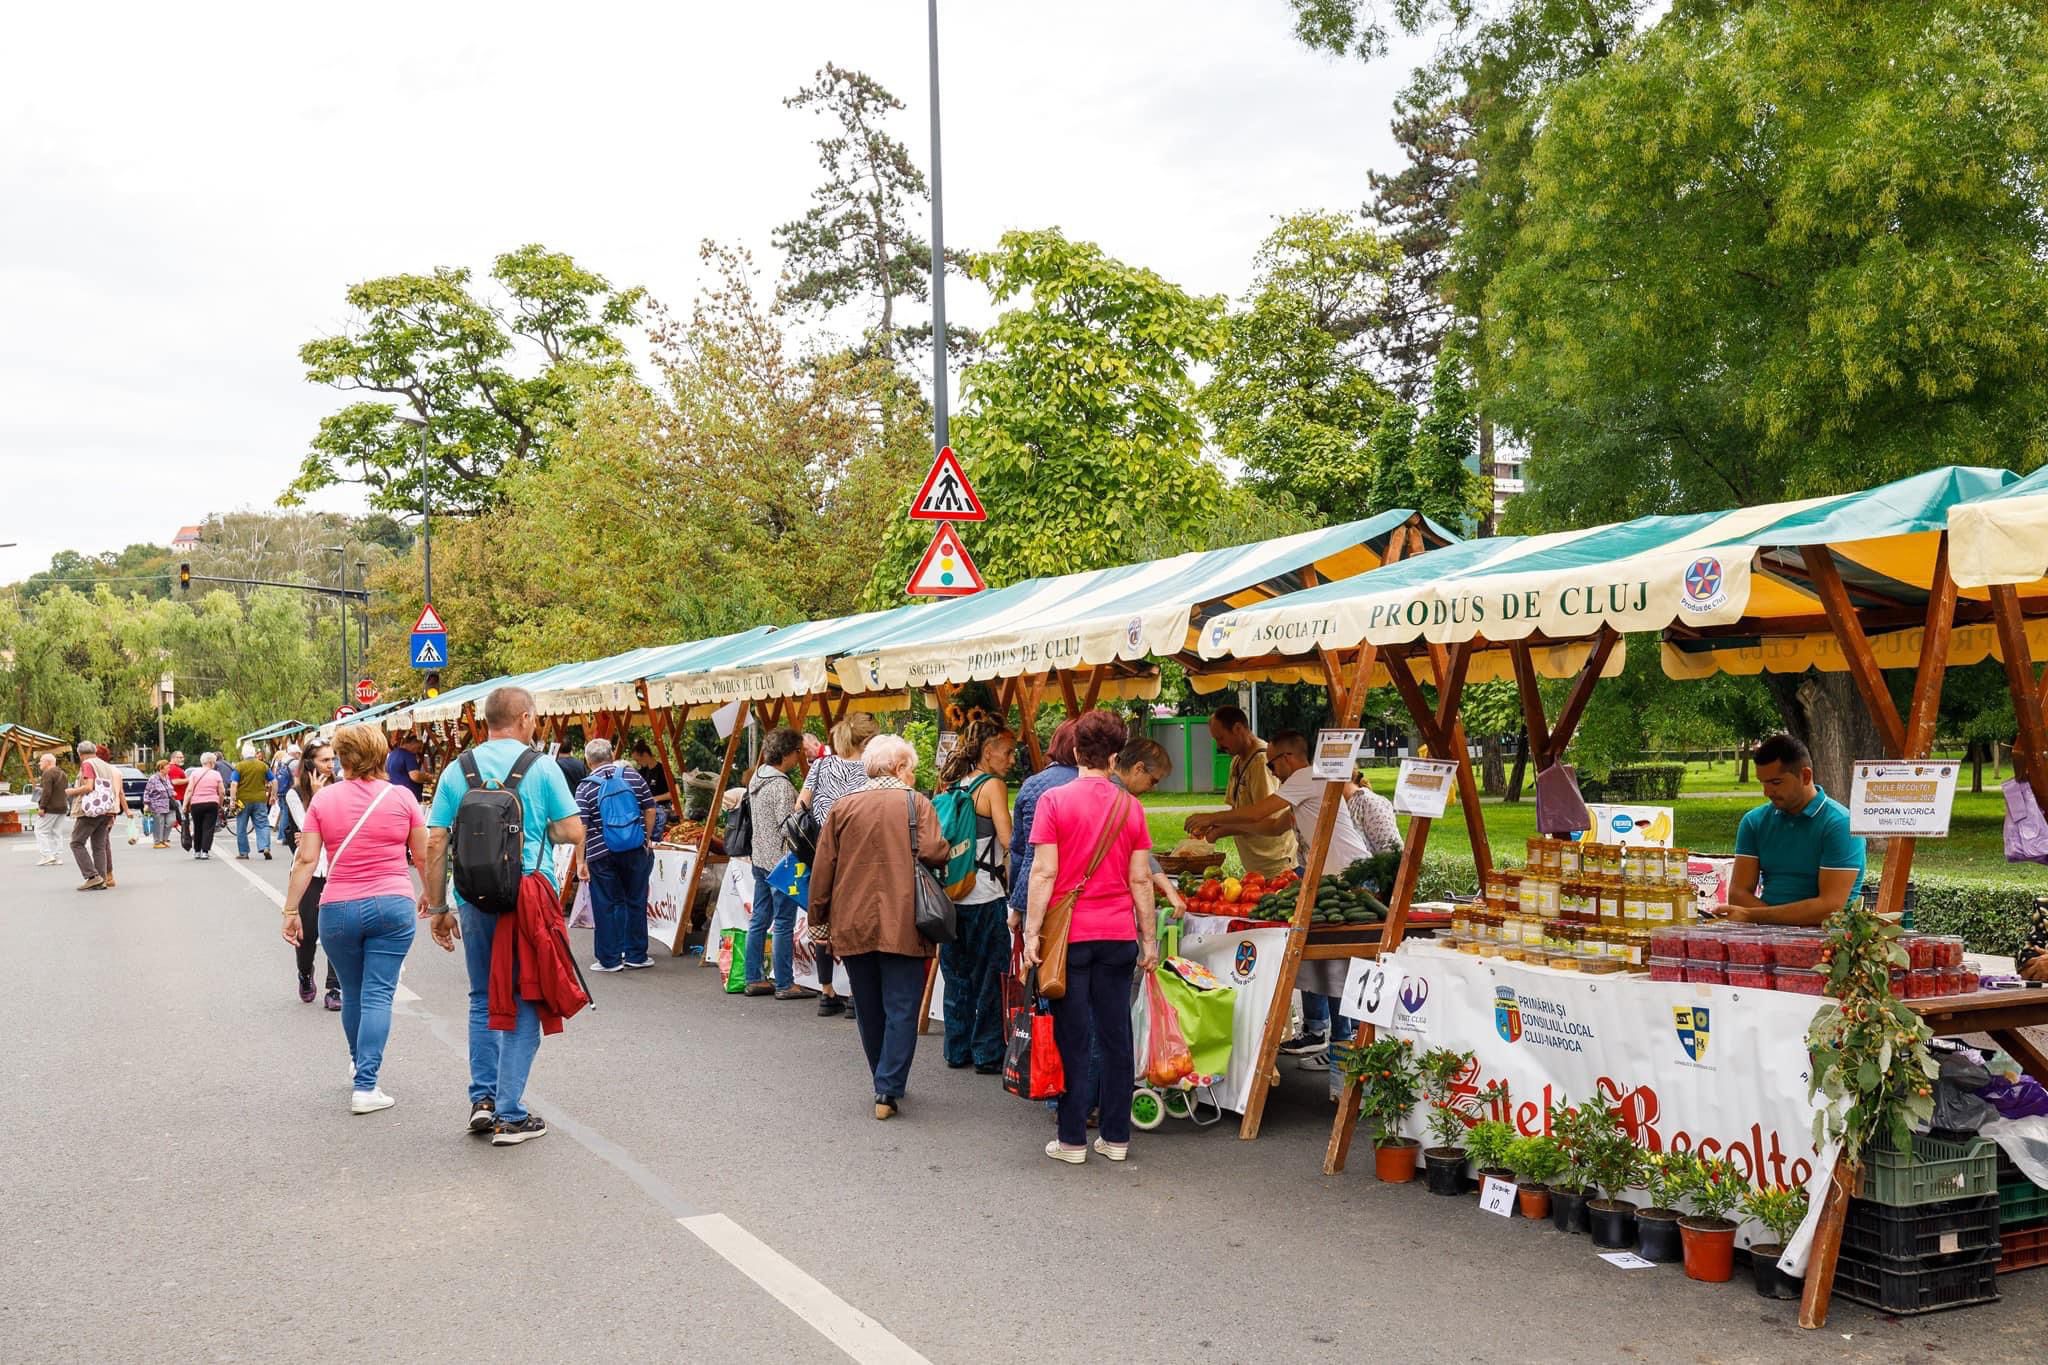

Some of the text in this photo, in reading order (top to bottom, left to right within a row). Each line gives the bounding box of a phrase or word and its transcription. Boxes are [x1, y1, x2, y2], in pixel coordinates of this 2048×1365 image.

[1368, 595, 1484, 629] PRODUS
[1501, 590, 1541, 620] DE
[1560, 581, 1648, 615] CLUJ
[1681, 597, 1702, 611] Produs
[1711, 594, 1727, 607] Cluj
[967, 649, 1016, 672] PRODUS
[1021, 643, 1039, 663] DE
[1045, 635, 1081, 660] CLUJ
[357, 687, 378, 697] STOP
[1863, 807, 1936, 816] SOPORAN VIORICA
[1357, 968, 1385, 1013] 13
[1521, 1012, 1595, 1038] CONSILIUL LOCAL
[1524, 1030, 1583, 1053] CLUJ-NAPOCA
[1597, 1076, 1821, 1197] Recolte
[1490, 1198, 1500, 1209] 10
